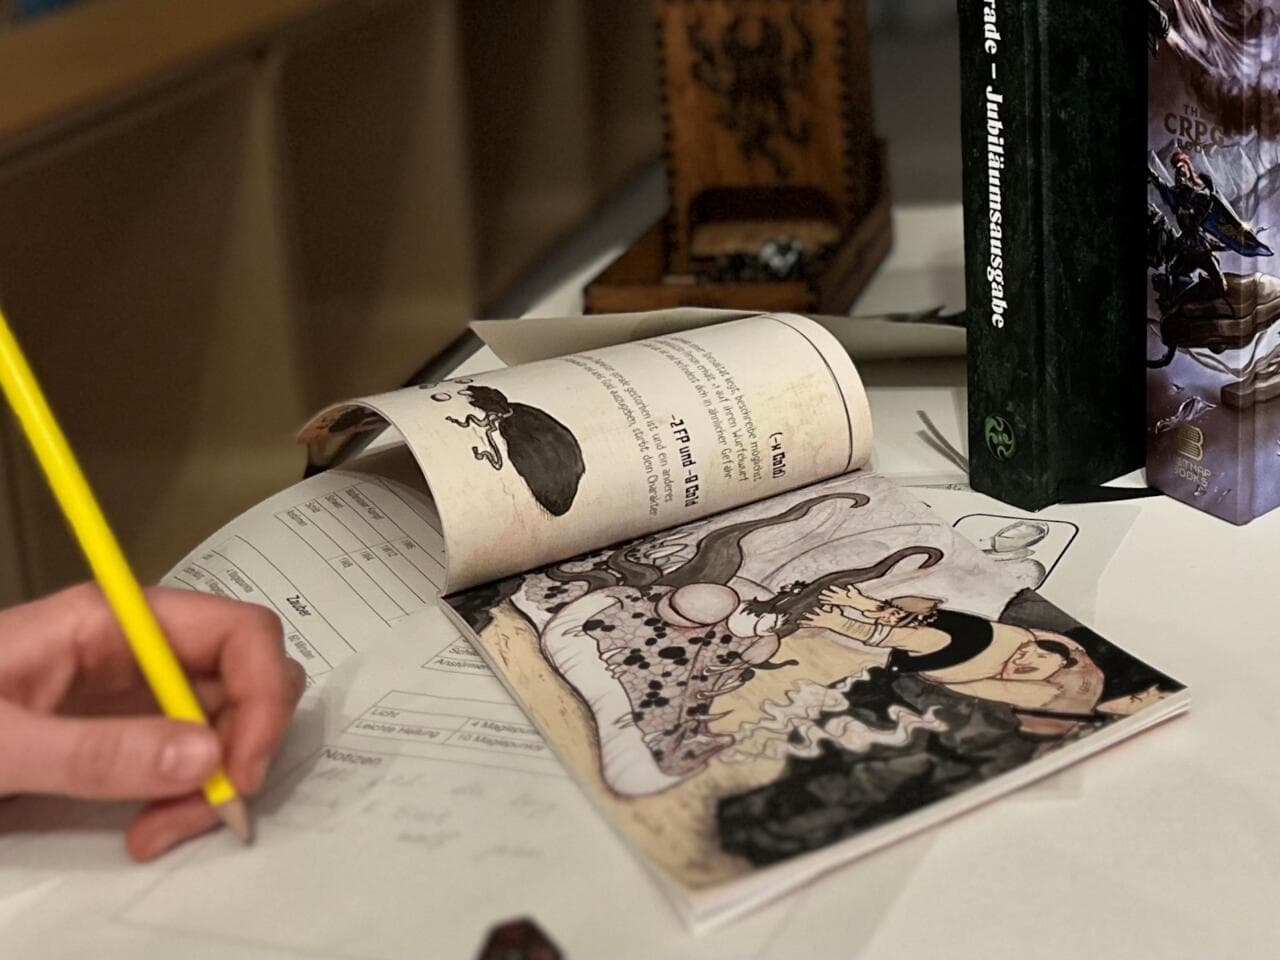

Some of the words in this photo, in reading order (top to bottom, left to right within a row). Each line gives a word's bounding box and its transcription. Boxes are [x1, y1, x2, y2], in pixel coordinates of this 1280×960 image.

[1164, 112, 1225, 147] CRPG
[986, 85, 1008, 329] Jubiläumsausgabe
[646, 419, 658, 432] ist
[669, 414, 685, 430] -2
[723, 405, 738, 429] ihren
[651, 433, 665, 452] und
[673, 427, 691, 444] FP
[735, 395, 757, 440] beschreibe
[750, 441, 763, 482] möglichst
[642, 453, 653, 474] dein
[658, 452, 669, 468] ein
[679, 446, 697, 468] und
[721, 448, 735, 481] Gefahr
[661, 468, 674, 504] anderes
[286, 594, 312, 618] Zauber
[370, 708, 400, 719] Licht
[399, 725, 441, 739] Heilung
[320, 746, 384, 766] Notizen
